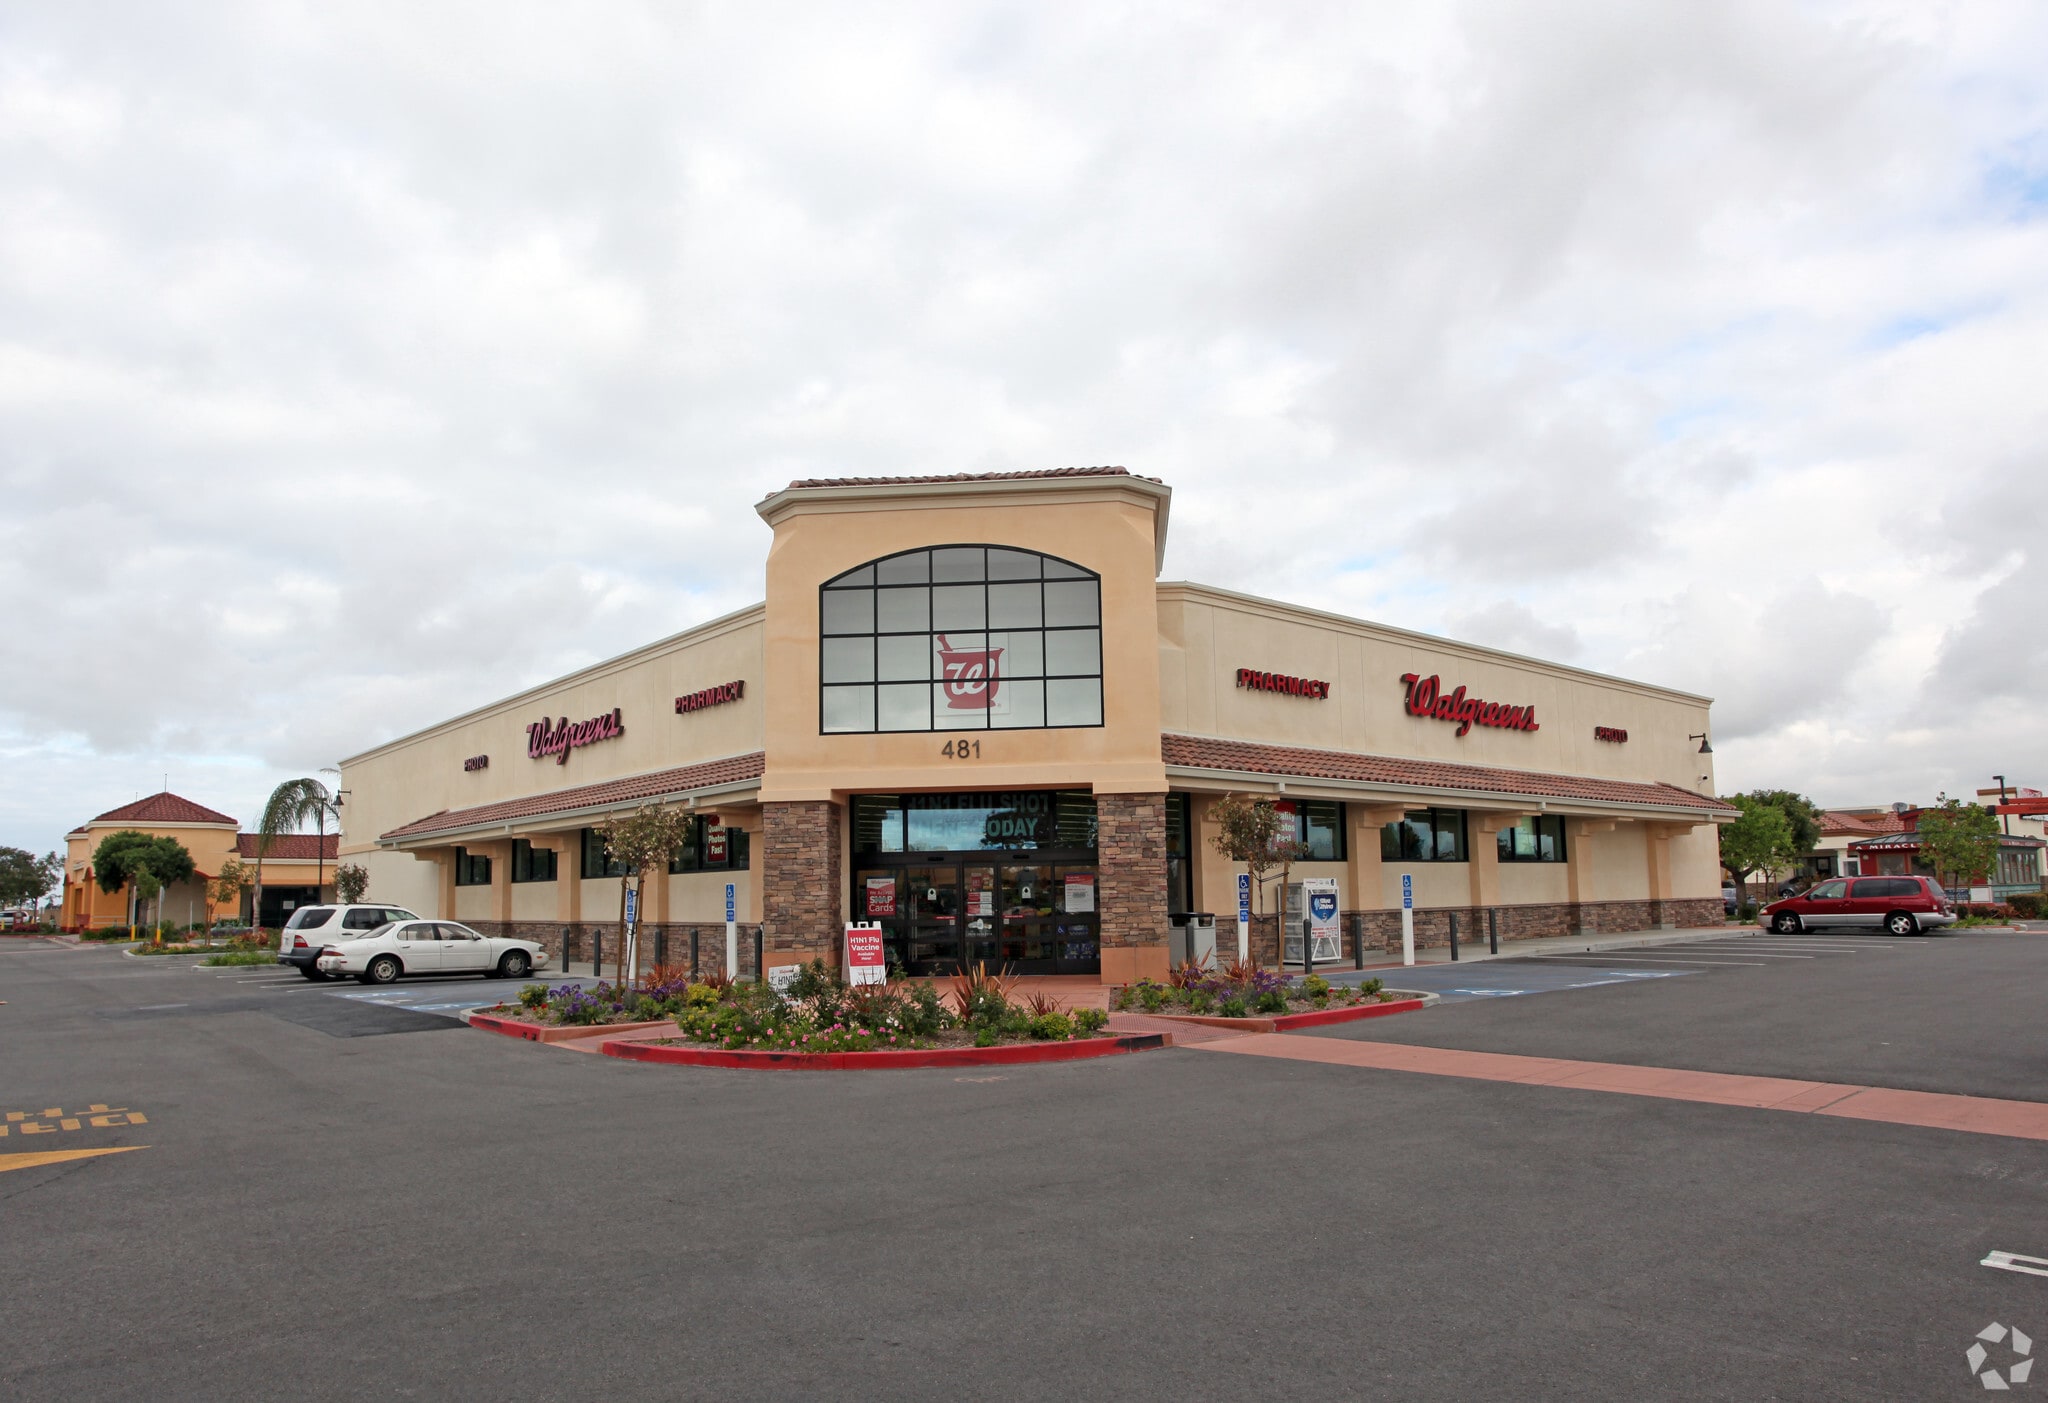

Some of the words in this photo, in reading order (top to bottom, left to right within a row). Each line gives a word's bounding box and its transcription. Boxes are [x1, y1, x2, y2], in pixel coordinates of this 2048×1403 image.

[1236, 668, 1330, 700] PHARMACY
[675, 680, 744, 714] PHARMACY
[1400, 673, 1540, 737] Walgreens
[526, 708, 624, 765] Walgreens
[1594, 726, 1629, 743] PHOTO
[941, 739, 980, 759] 481
[464, 755, 489, 771] PHOTO
[707, 835, 726, 844] Photos
[711, 845, 723, 855] Fast
[868, 903, 894, 912] Cards
[850, 936, 867, 944] H1N1
[851, 943, 880, 951] Vaccine
